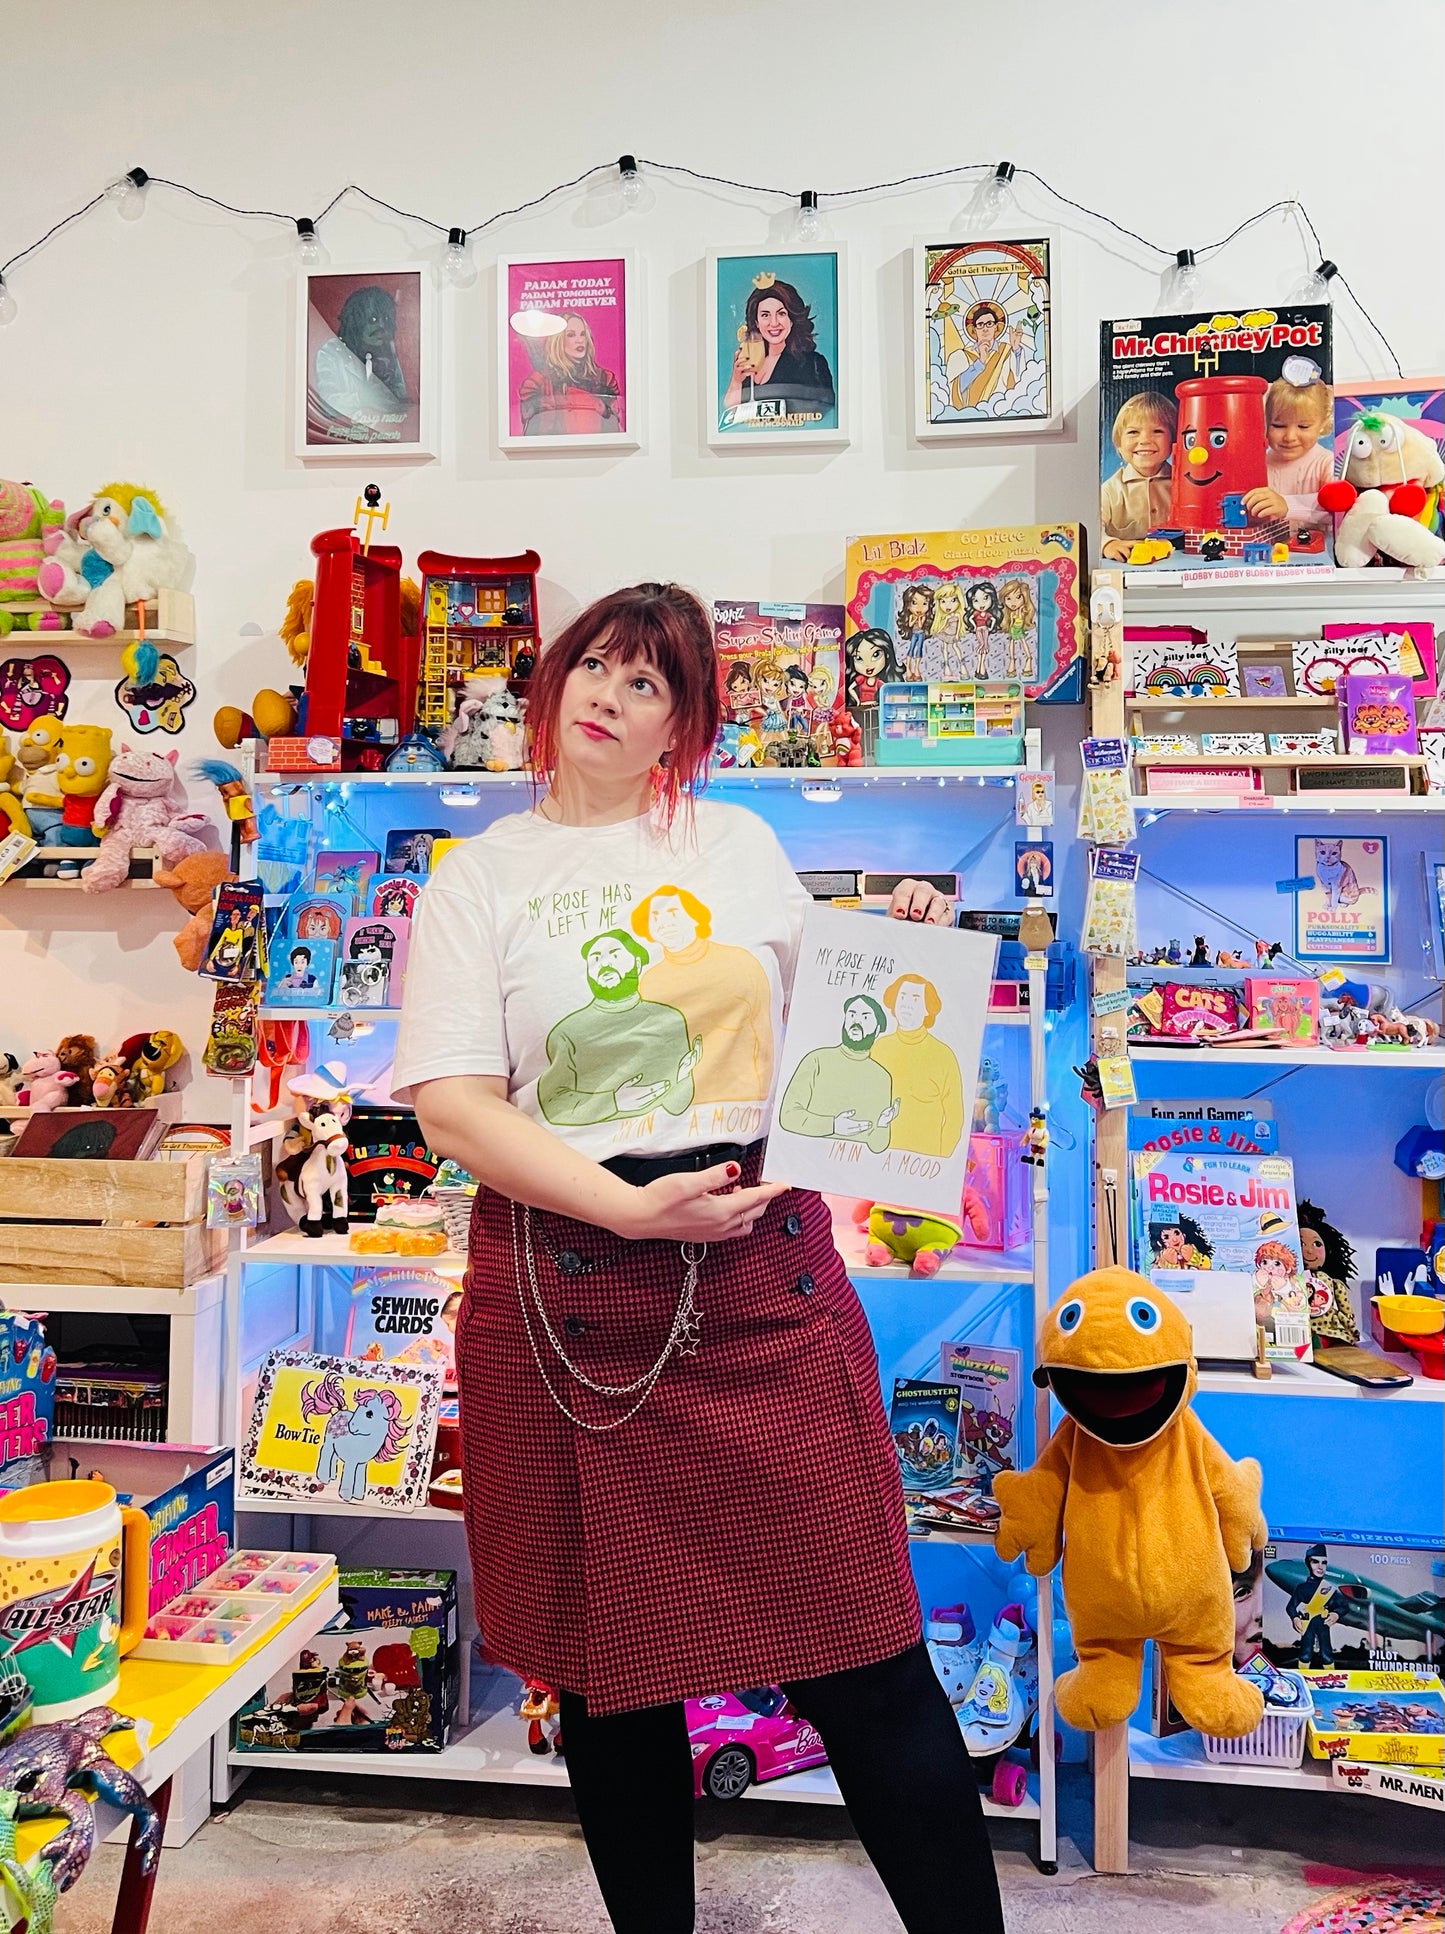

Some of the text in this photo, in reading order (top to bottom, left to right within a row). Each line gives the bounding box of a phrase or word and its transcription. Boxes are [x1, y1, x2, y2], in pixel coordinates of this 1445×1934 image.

[967, 266, 979, 274] Get
[980, 265, 1009, 273] Theroux
[1011, 263, 1026, 271] This
[520, 288, 616, 300] PADAM TOMORROW
[523, 277, 612, 291] PADAM TODAY
[519, 296, 617, 310] PADAM FOREVER
[1114, 336, 1153, 358] Mr.
[1272, 324, 1321, 347] Pot
[960, 530, 1026, 548] 60 piece
[1184, 570, 1213, 581] BLOBBY
[1214, 569, 1244, 579] BLOBBY
[1246, 568, 1274, 577] BLOBBY
[1275, 567, 1305, 577] BLOBBY
[1306, 566, 1335, 576] BLOBBY
[718, 623, 842, 650] Super Game
[1163, 652, 1207, 662] silly loaf
[1324, 646, 1368, 656] silly loaf
[528, 883, 632, 921] MY ROSE HAS
[547, 905, 617, 938] LEFT ME
[1307, 911, 1362, 924] POLLY
[815, 947, 895, 975] MY ROSE HAS
[827, 968, 880, 992] LEFT ME
[1174, 988, 1228, 1014] CATS
[688, 1108, 699, 1137] A
[711, 1106, 761, 1135] MOOD
[1151, 1107, 1254, 1121] Fun and Games
[1143, 1125, 1264, 1154] Rosie & Jim
[882, 1154, 892, 1172] A
[897, 1155, 941, 1180] MOOD
[1203, 1160, 1250, 1174] FUN TO LEARN
[1148, 1172, 1290, 1210] Rosie & Jim
[388, 1270, 423, 1281] Little
[424, 1270, 452, 1290] Pony
[371, 1295, 439, 1316] SEWING
[375, 1315, 434, 1335] CARDS
[896, 1387, 959, 1398] GHOSTBUSTERS
[274, 1423, 321, 1445] Bow Tie
[151, 1501, 219, 1583] FINGER
[1351, 1532, 1404, 1543] puzzle
[1369, 1554, 1411, 1565] 100 PIECES
[2, 1585, 114, 1631] ALL-STAR
[367, 1605, 394, 1621] MAKE
[1369, 1649, 1398, 1661] PILOT
[1368, 1660, 1441, 1674] THUNDERBIRD
[796, 1725, 824, 1755] Bar
[1379, 1775, 1444, 1802] MR. MEN
